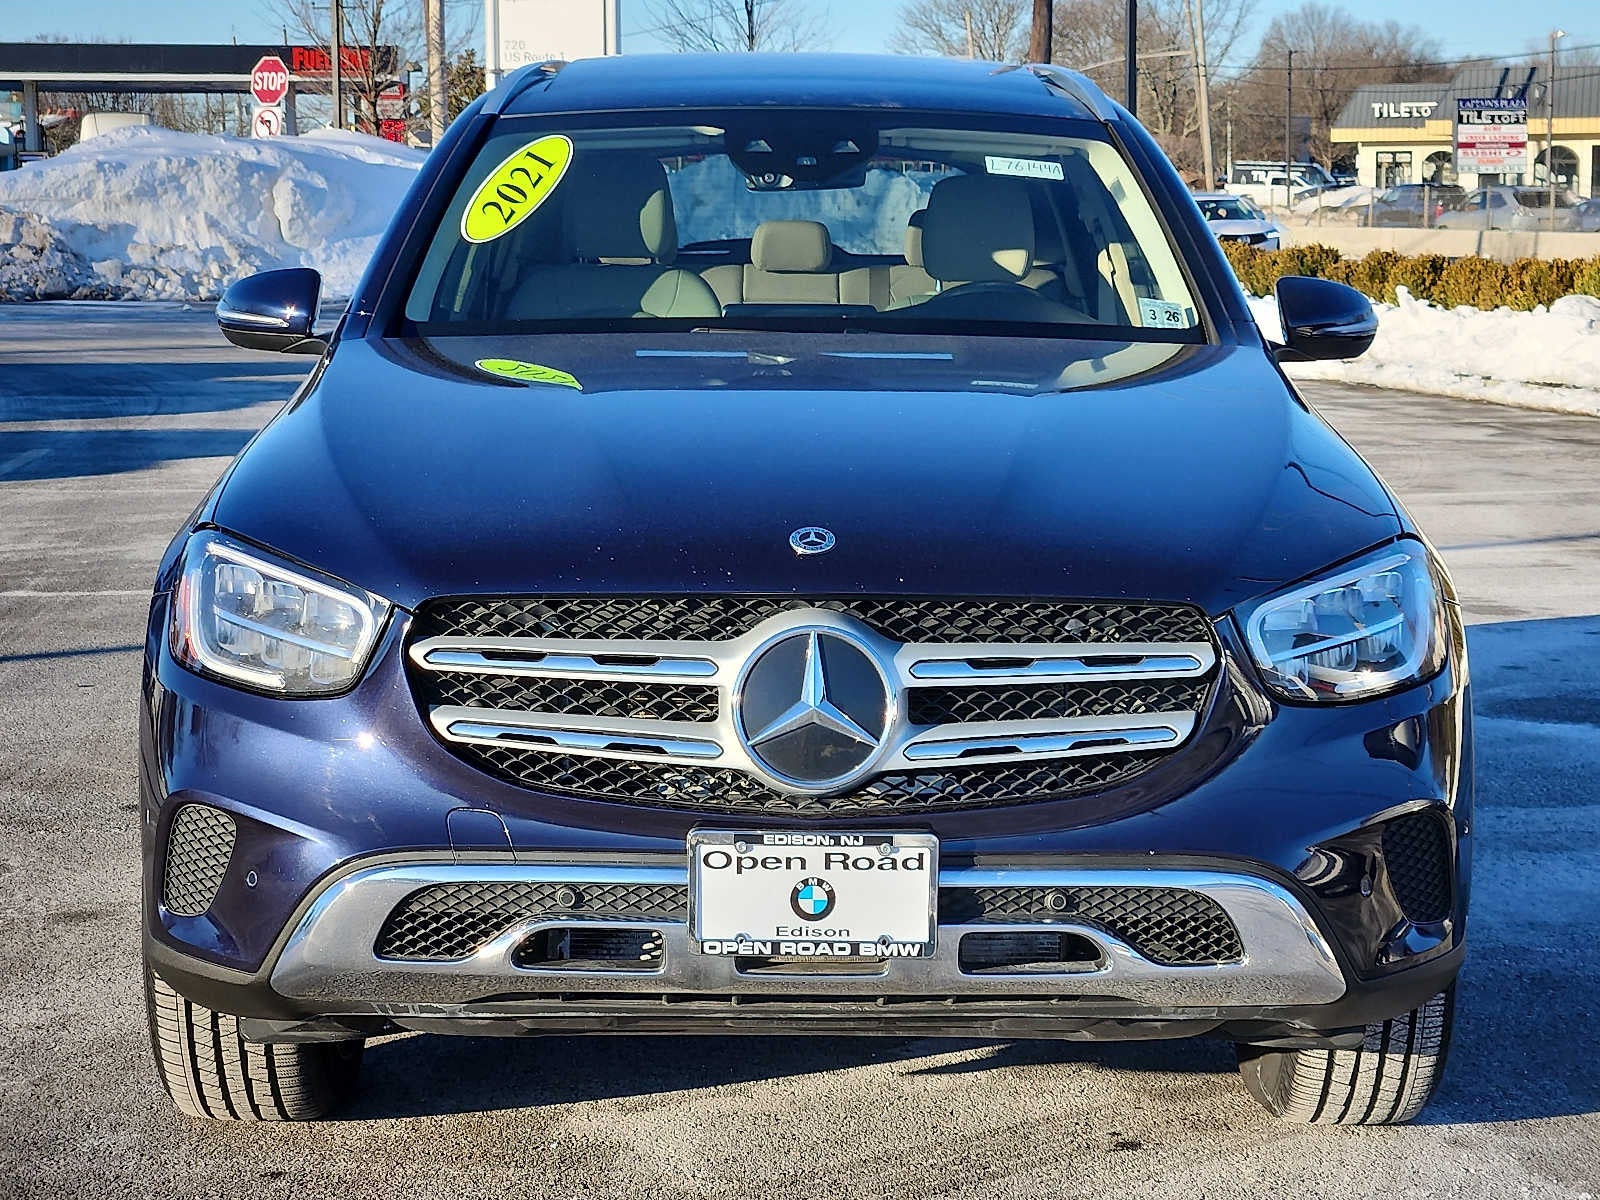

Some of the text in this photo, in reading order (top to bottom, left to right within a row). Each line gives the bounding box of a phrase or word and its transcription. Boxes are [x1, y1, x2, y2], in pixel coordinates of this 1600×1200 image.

[504, 40, 526, 50] 720
[504, 51, 521, 62] US
[254, 72, 286, 91] STOP
[1459, 110, 1526, 124] TILE LOFT
[482, 151, 557, 225] 2021
[1149, 309, 1180, 322] 3 26
[763, 834, 864, 847] EDISON, NJ
[703, 850, 924, 874] Open Road
[797, 877, 832, 892] BMW
[775, 926, 851, 938] Edison
[702, 941, 922, 957] OPEN ROAD BMW
